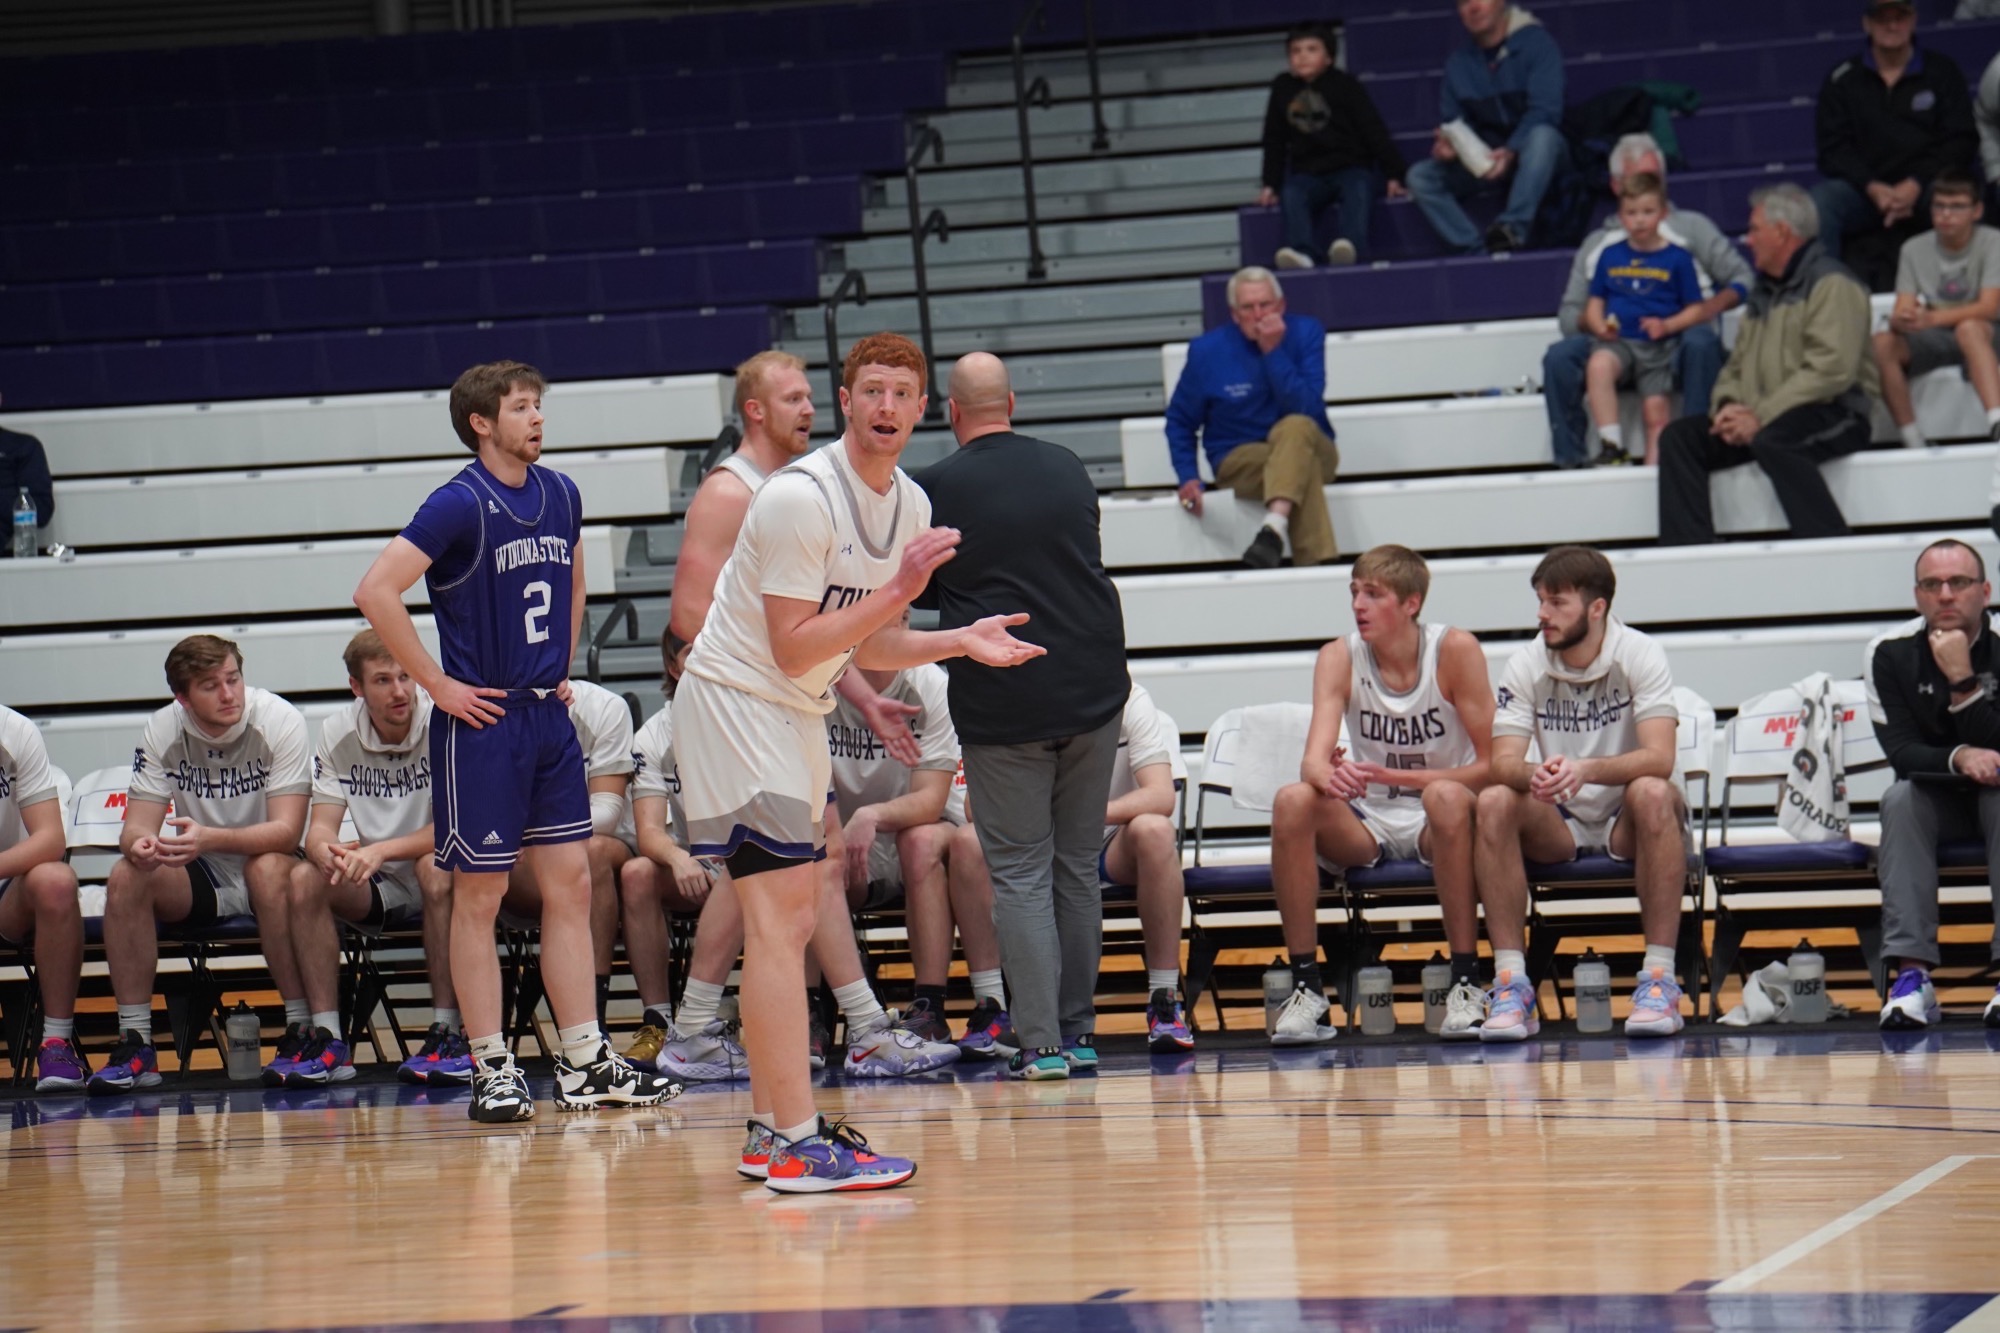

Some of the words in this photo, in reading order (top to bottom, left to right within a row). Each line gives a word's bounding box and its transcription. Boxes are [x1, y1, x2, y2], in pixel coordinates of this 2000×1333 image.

[495, 537, 539, 574] WINONA
[539, 535, 571, 566] STTE
[523, 580, 552, 644] 2
[830, 724, 875, 760] SIOUX
[219, 758, 265, 799] FALLS
[350, 764, 392, 797] SIOUX
[1794, 978, 1821, 996] USF
